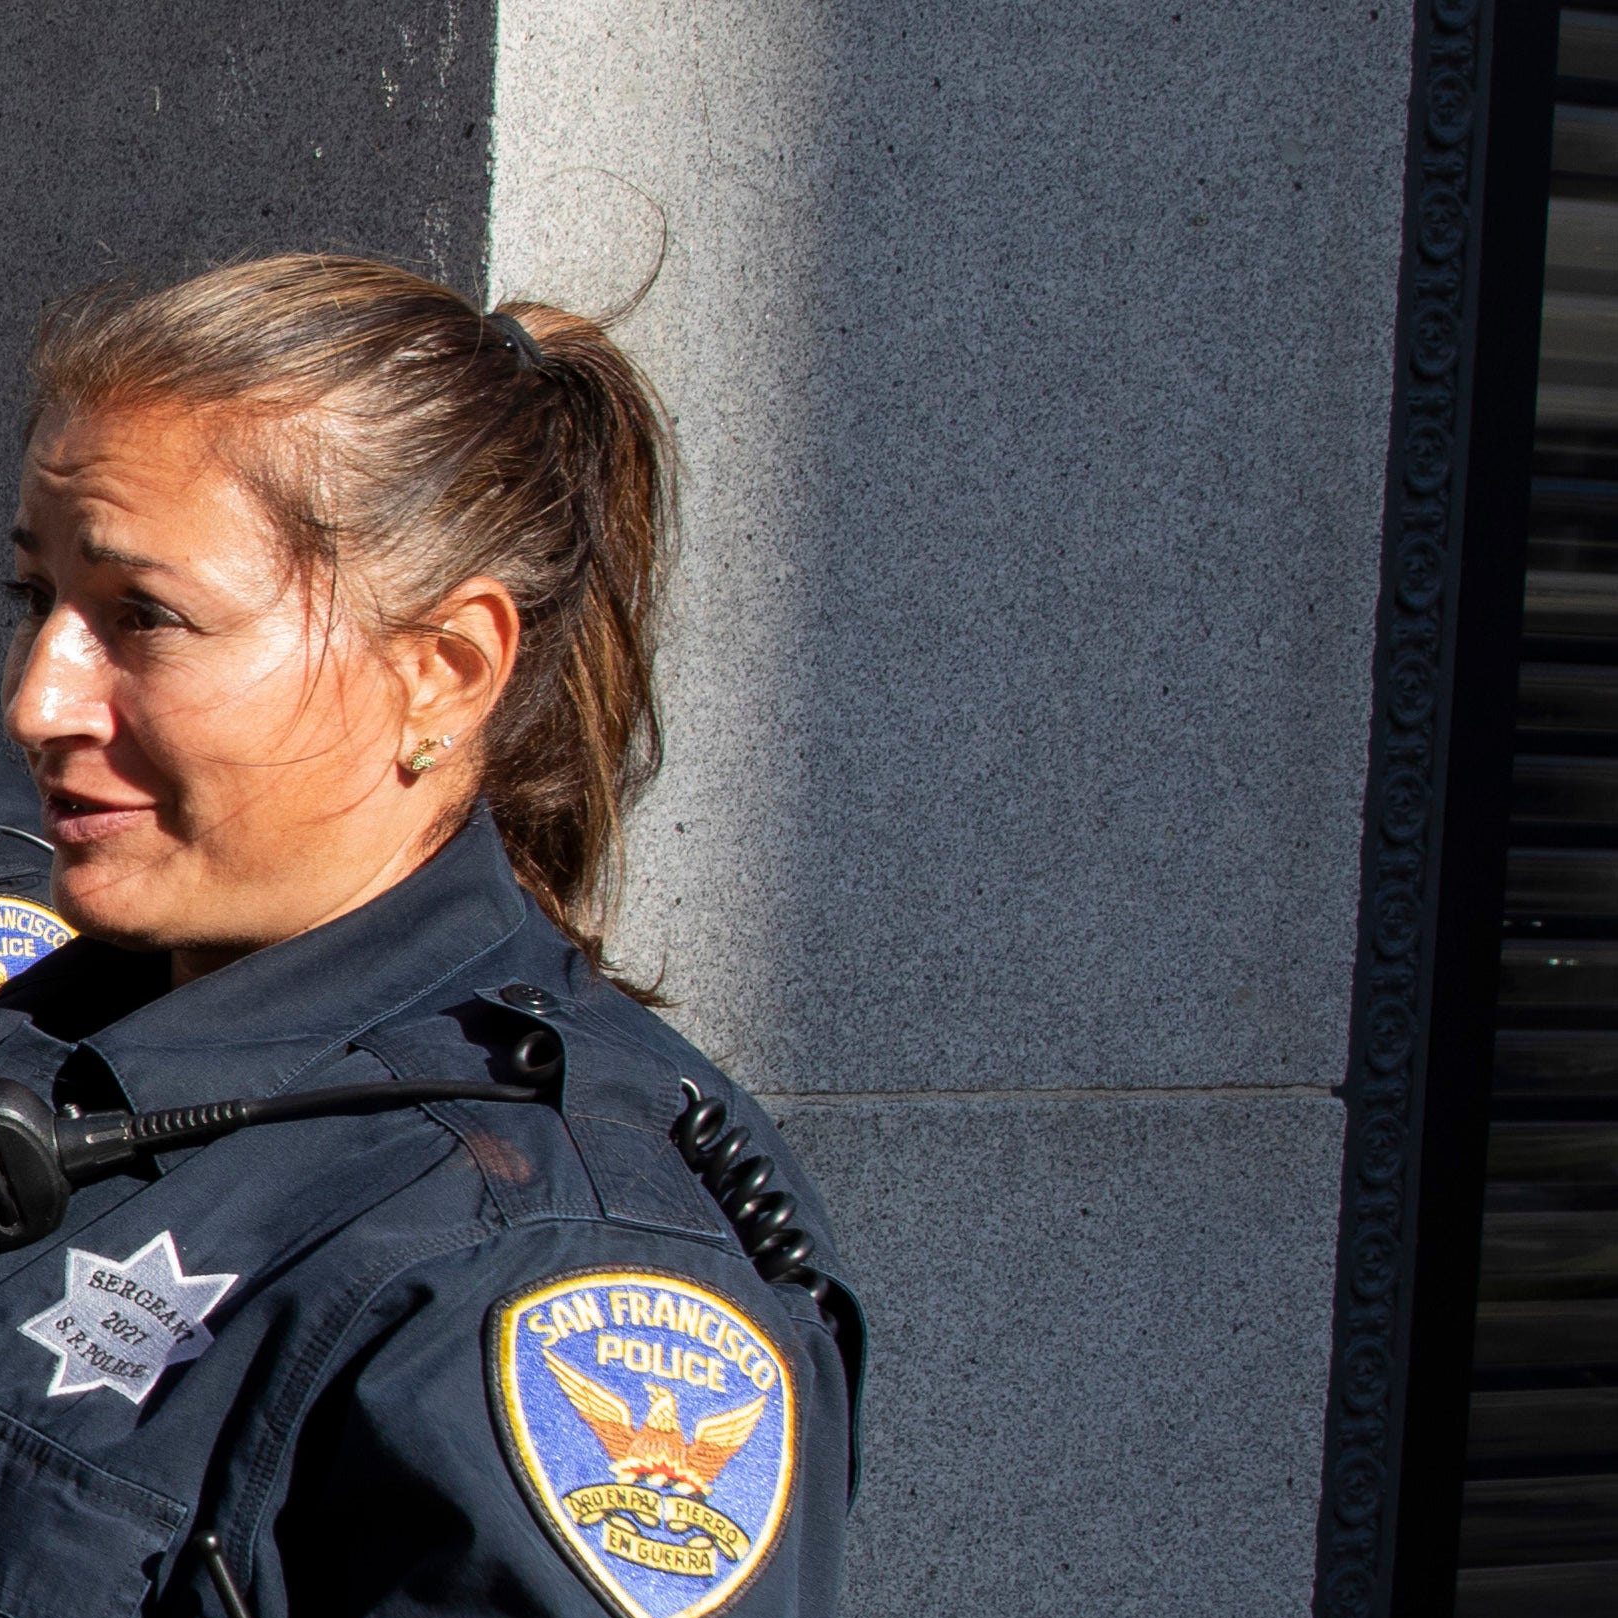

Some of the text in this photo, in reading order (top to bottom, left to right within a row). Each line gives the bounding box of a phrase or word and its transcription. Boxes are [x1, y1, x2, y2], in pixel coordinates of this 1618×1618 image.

[87, 1269, 196, 1345] SERGEANT
[100, 1311, 151, 1346] 2027
[80, 1342, 148, 1380] POLICE
[526, 1291, 778, 1393] SAN FRANCISCO
[596, 1334, 727, 1394] POLICE
[569, 1484, 739, 1545] ORO EN PAZ FIERRO
[608, 1529, 712, 1573] EN GUERRA
